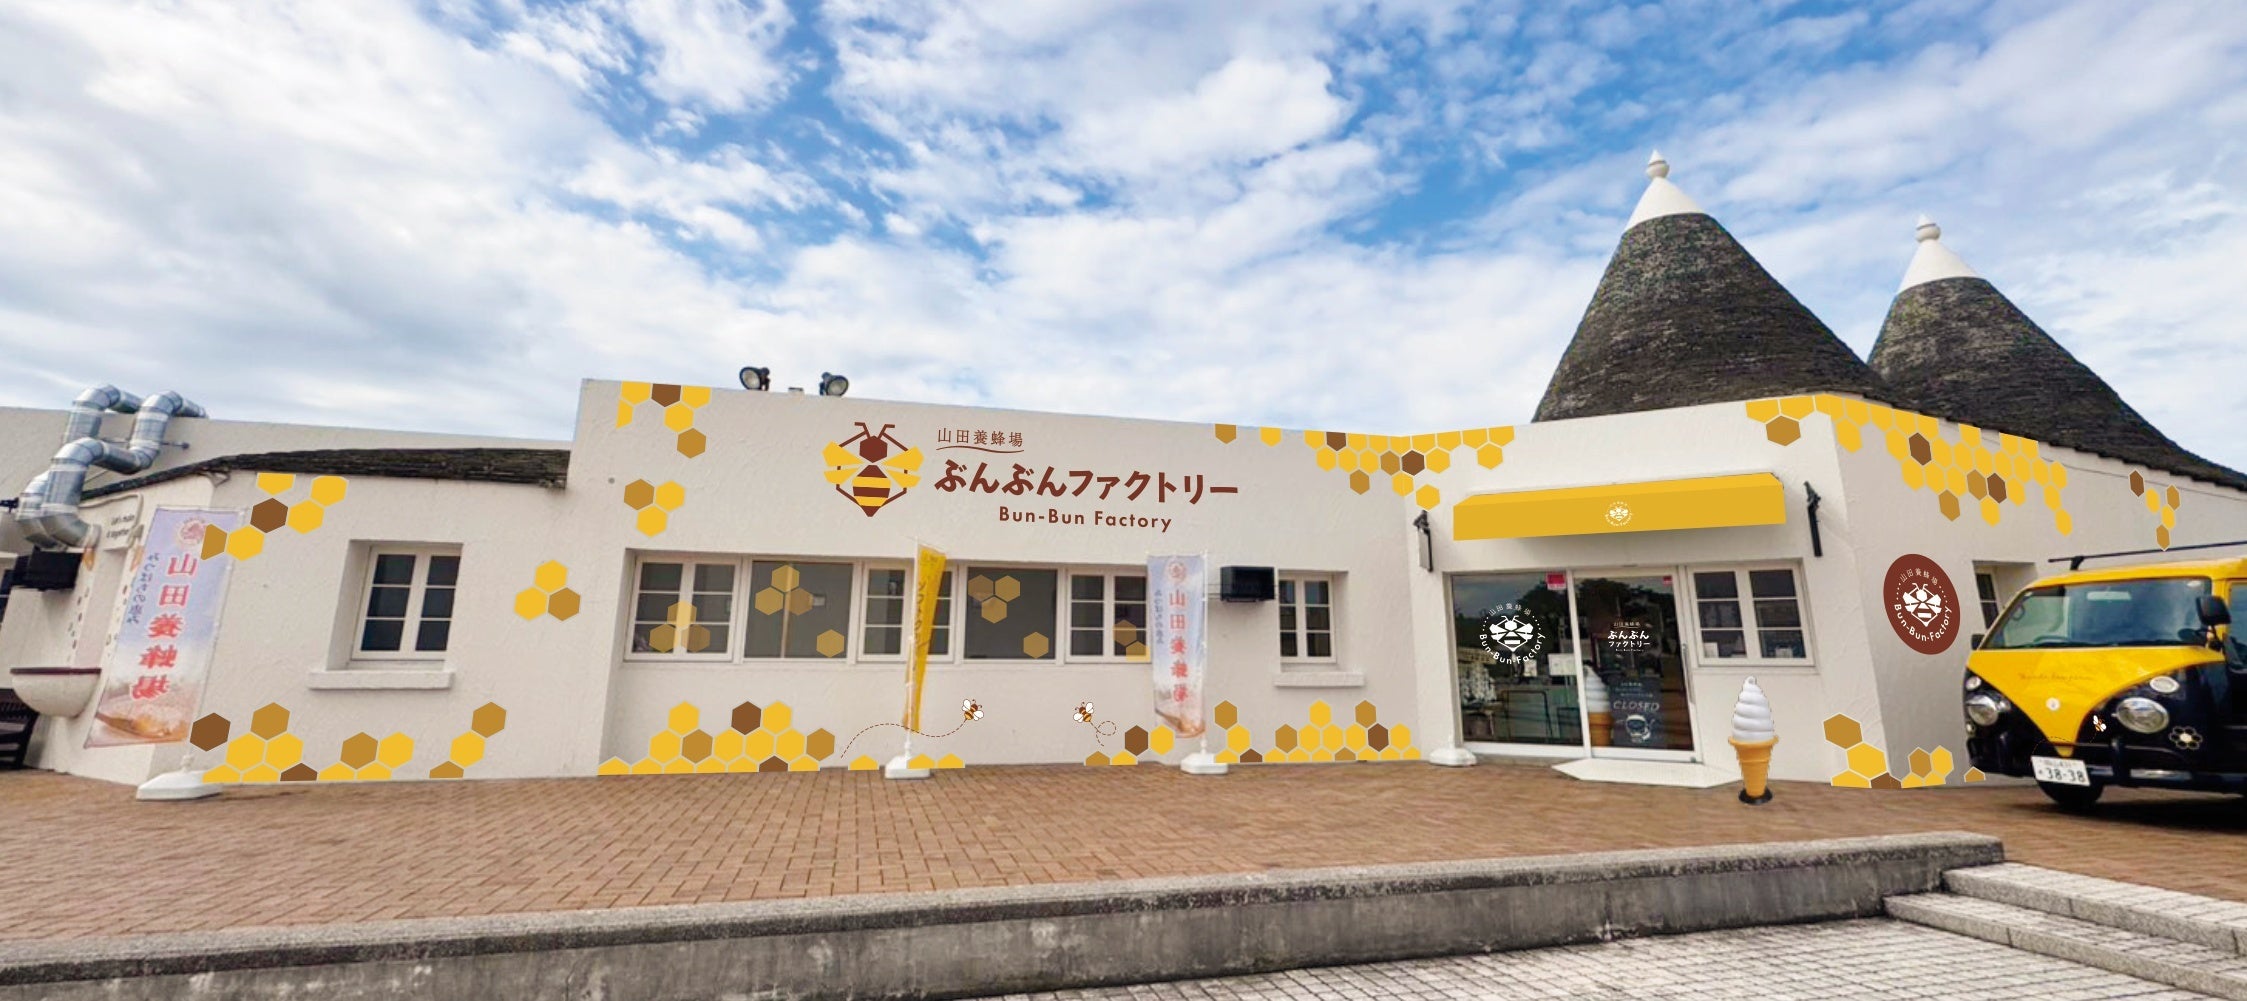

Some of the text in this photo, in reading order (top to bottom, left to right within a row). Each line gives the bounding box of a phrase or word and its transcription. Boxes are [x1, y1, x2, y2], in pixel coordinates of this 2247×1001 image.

[937, 427, 1024, 448] 山田養蜂場
[934, 459, 1238, 505] ぶんぶんファクトリー
[999, 506, 1172, 533] Bun-Bun Factory
[1607, 630, 1650, 640] ぶんぶん
[1608, 640, 1651, 648] ファクトリー
[1613, 701, 1660, 712] CLOSED
